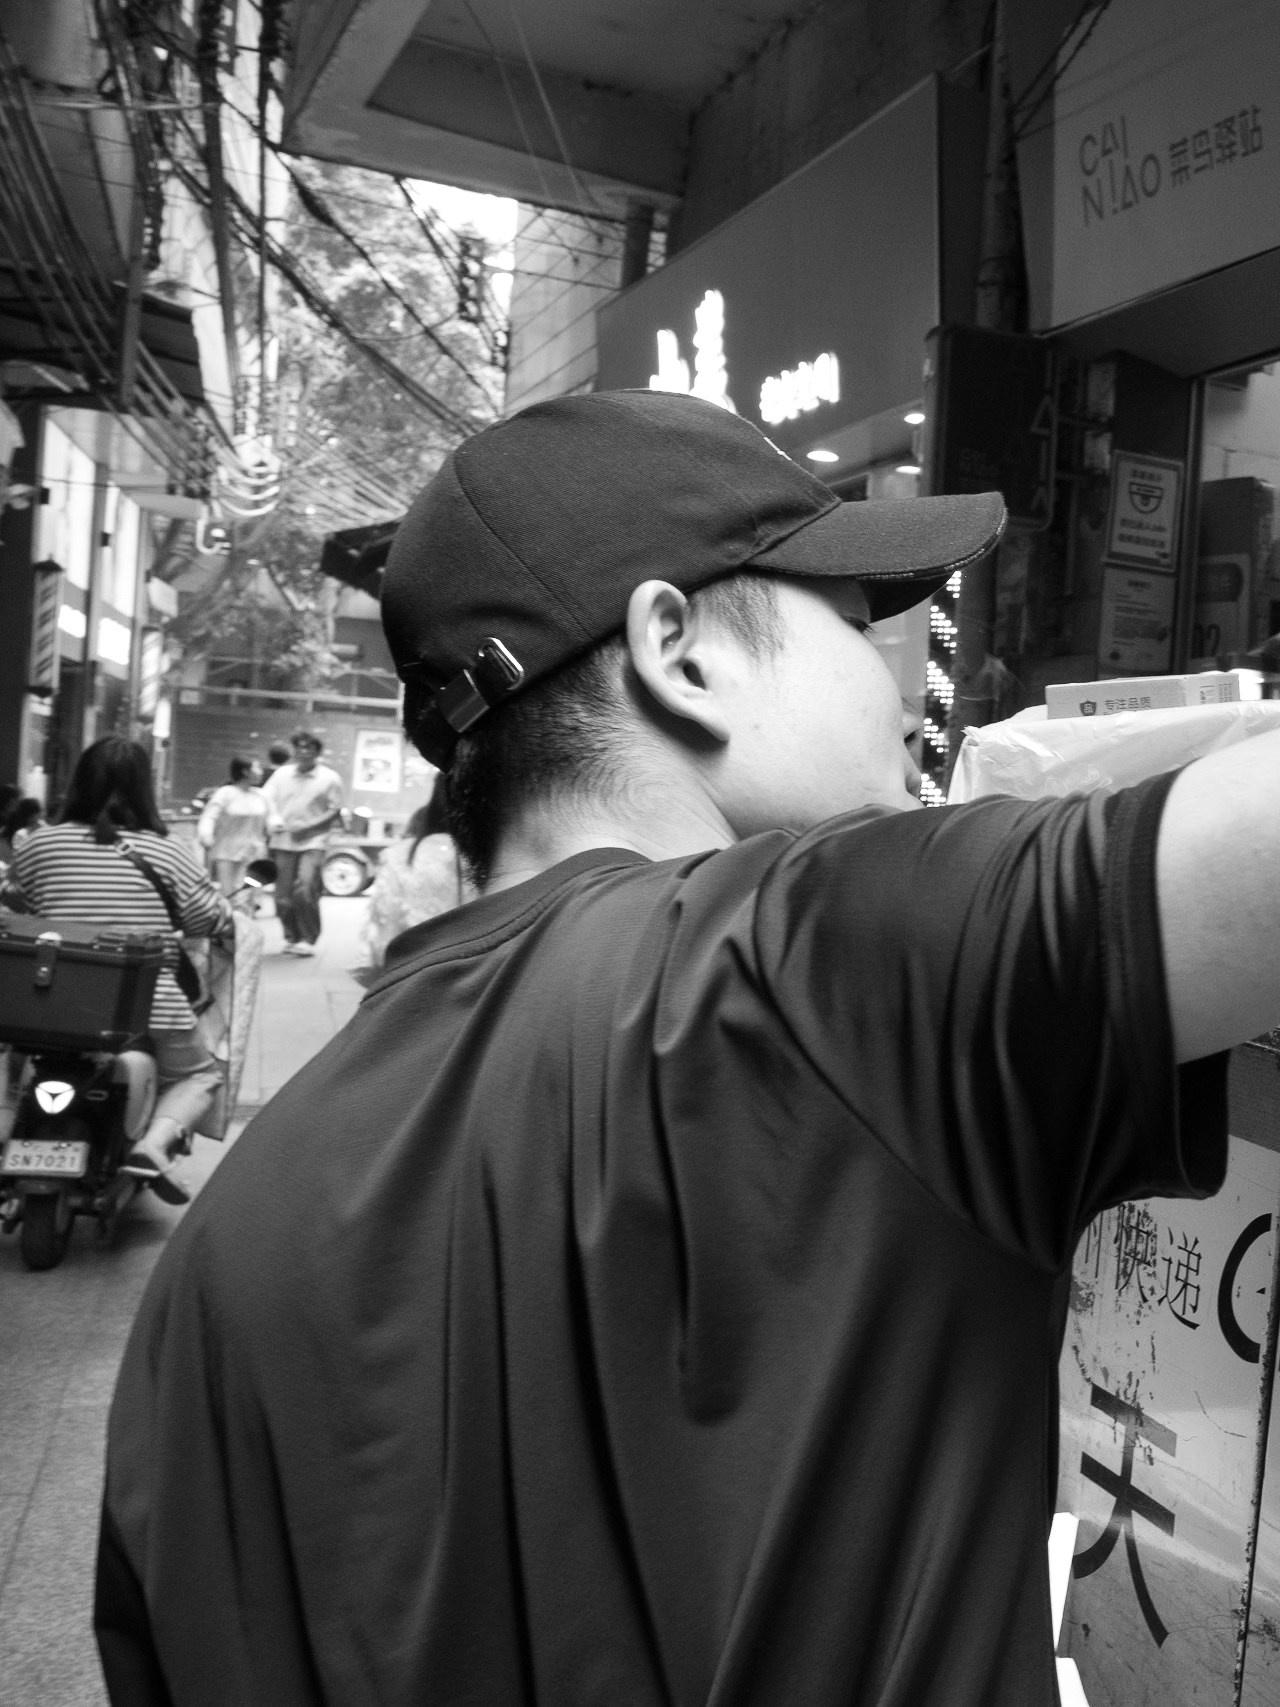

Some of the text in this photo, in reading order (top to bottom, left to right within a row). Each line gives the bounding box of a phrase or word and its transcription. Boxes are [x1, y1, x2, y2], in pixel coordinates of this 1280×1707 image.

[1079, 114, 1129, 176] CAI
[1168, 104, 1263, 188] 菜鸟驿站
